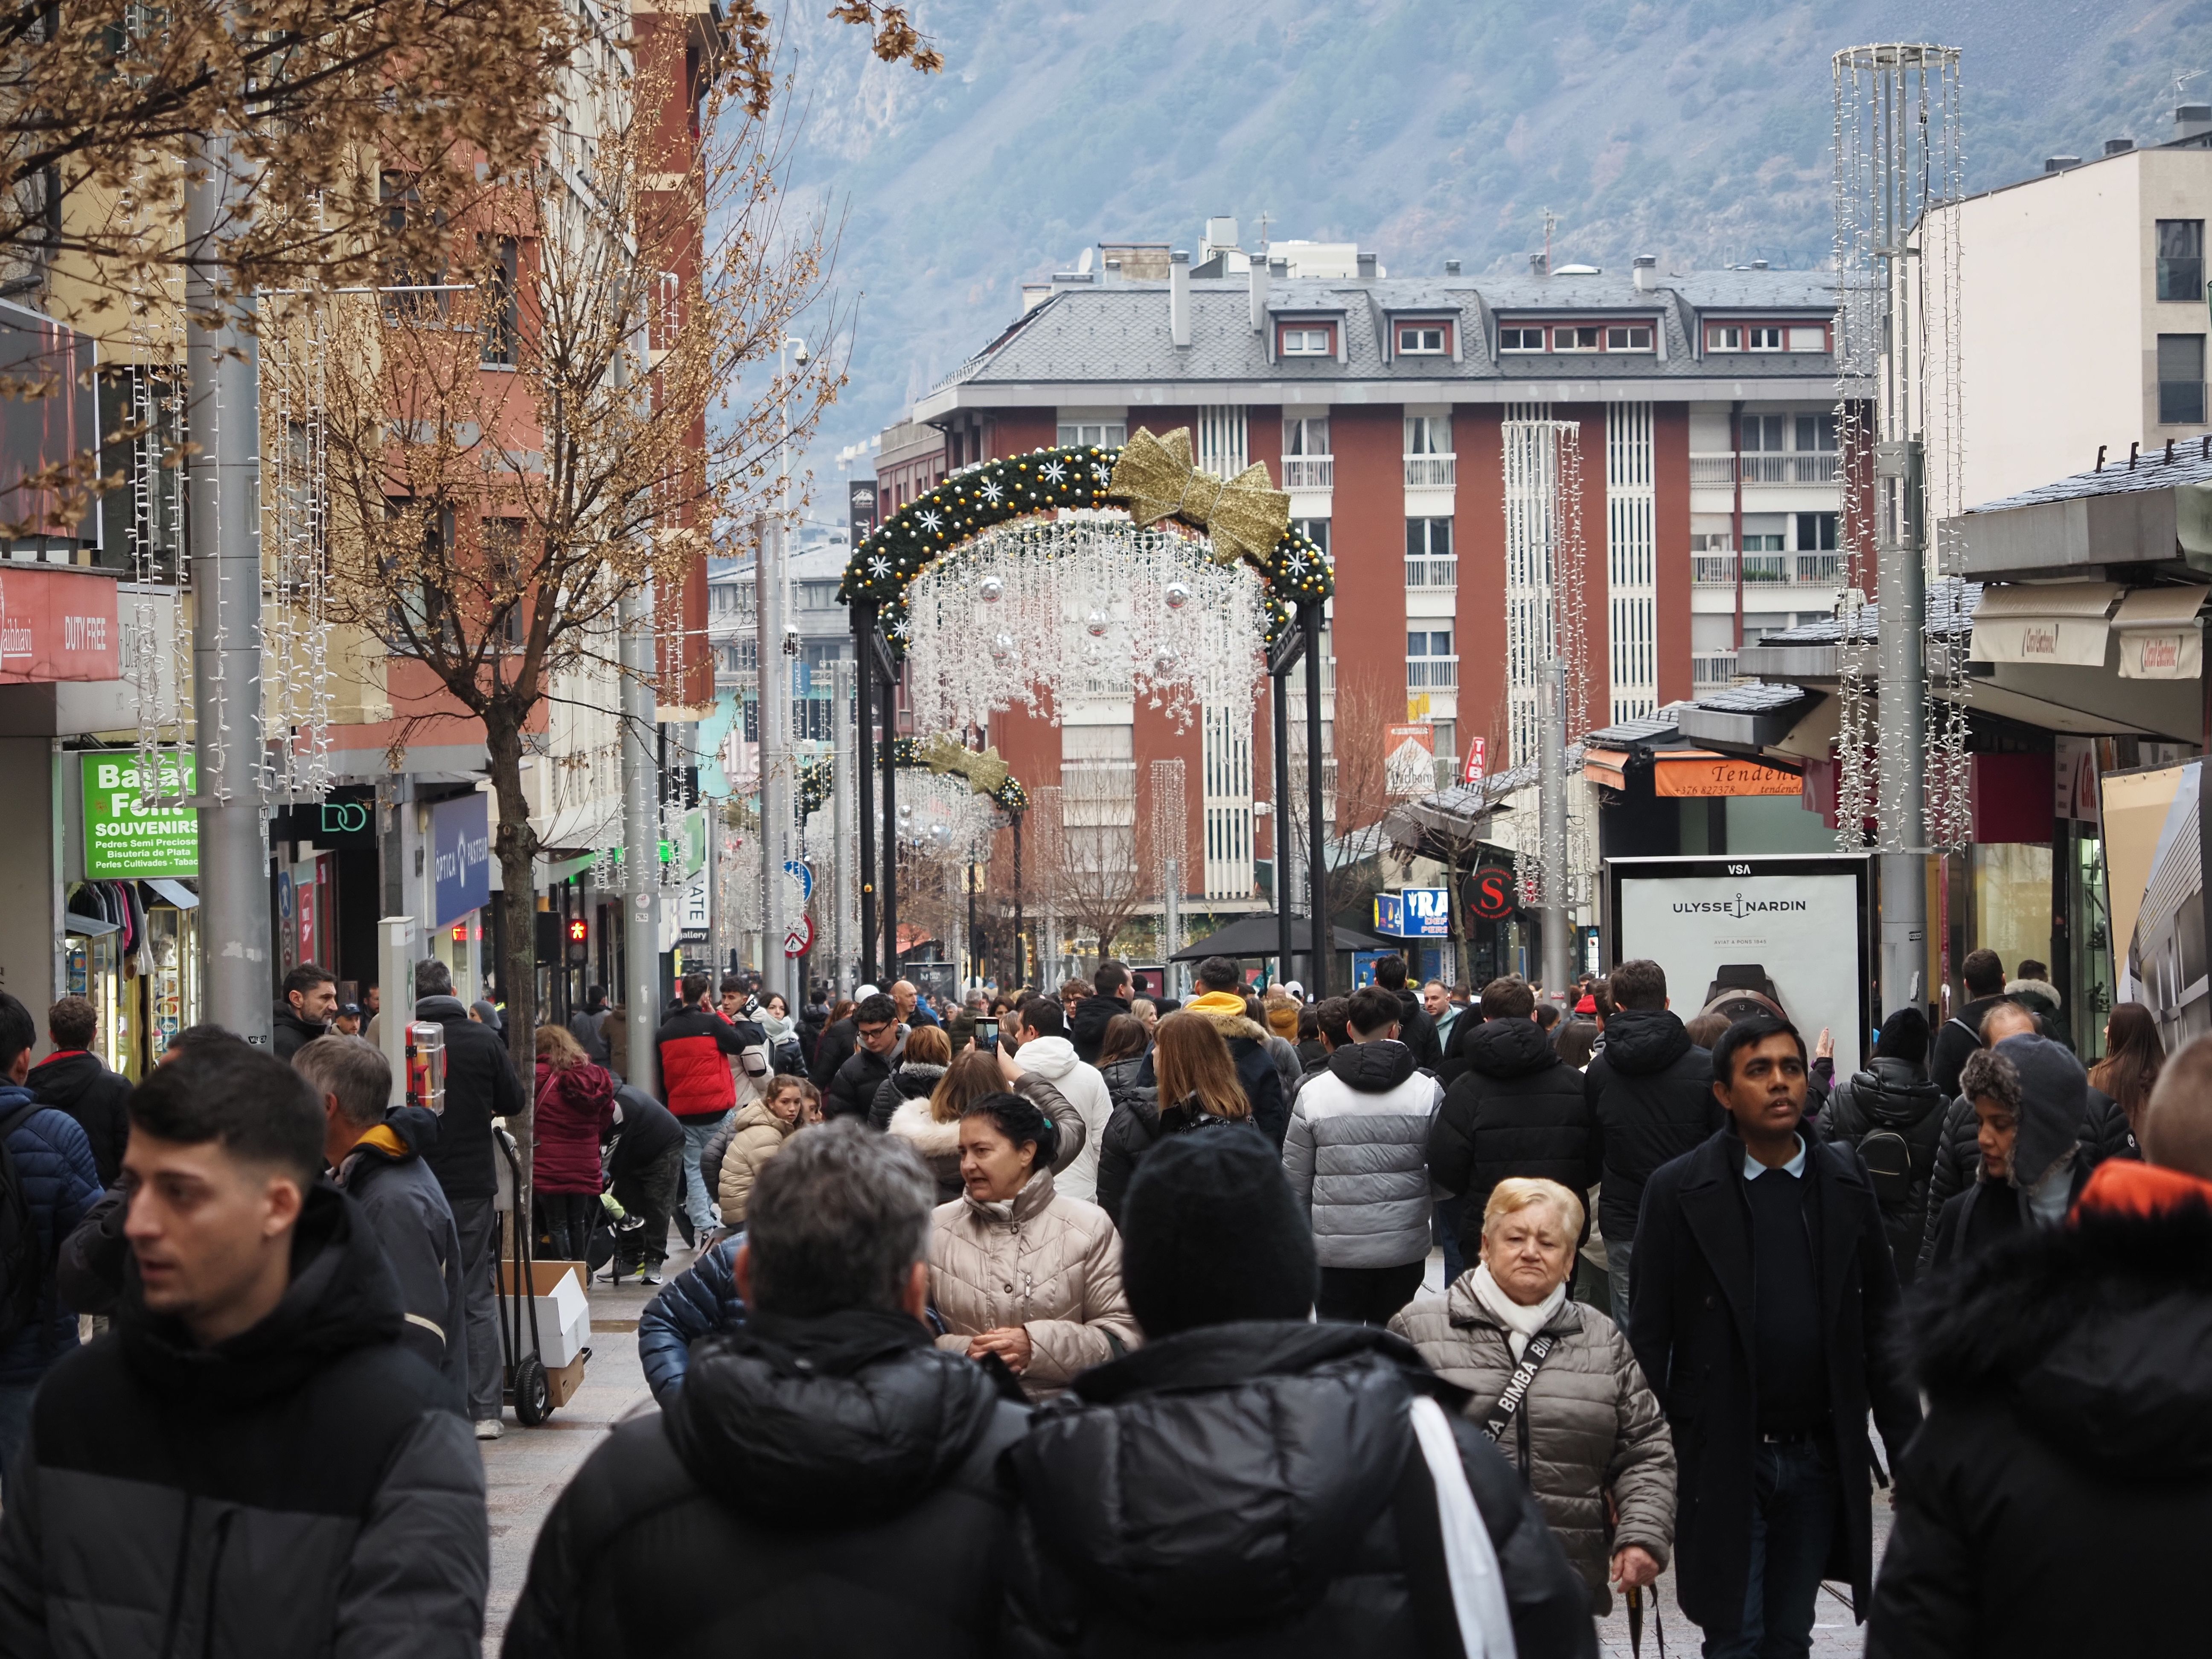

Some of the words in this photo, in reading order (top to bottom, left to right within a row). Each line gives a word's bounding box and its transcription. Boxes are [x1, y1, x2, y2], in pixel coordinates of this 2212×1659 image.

[65, 616, 85, 651] DUTY
[86, 617, 106, 650] FREE
[1674, 787, 1698, 795] +376
[1701, 786, 1736, 794] 827378
[95, 820, 198, 836] SOUVENIRS
[130, 839, 154, 847] Semi
[156, 838, 198, 846] Preciose
[107, 849, 150, 858] Bisutería
[96, 860, 122, 868] Perles
[123, 859, 167, 867] Cultivades
[1481, 878, 1504, 909] S
[690, 885, 704, 920] ATE
[1673, 902, 1732, 913] ULYSSE
[1746, 901, 1806, 911] NARDIN
[1498, 1362, 1538, 1413] BIMBA
